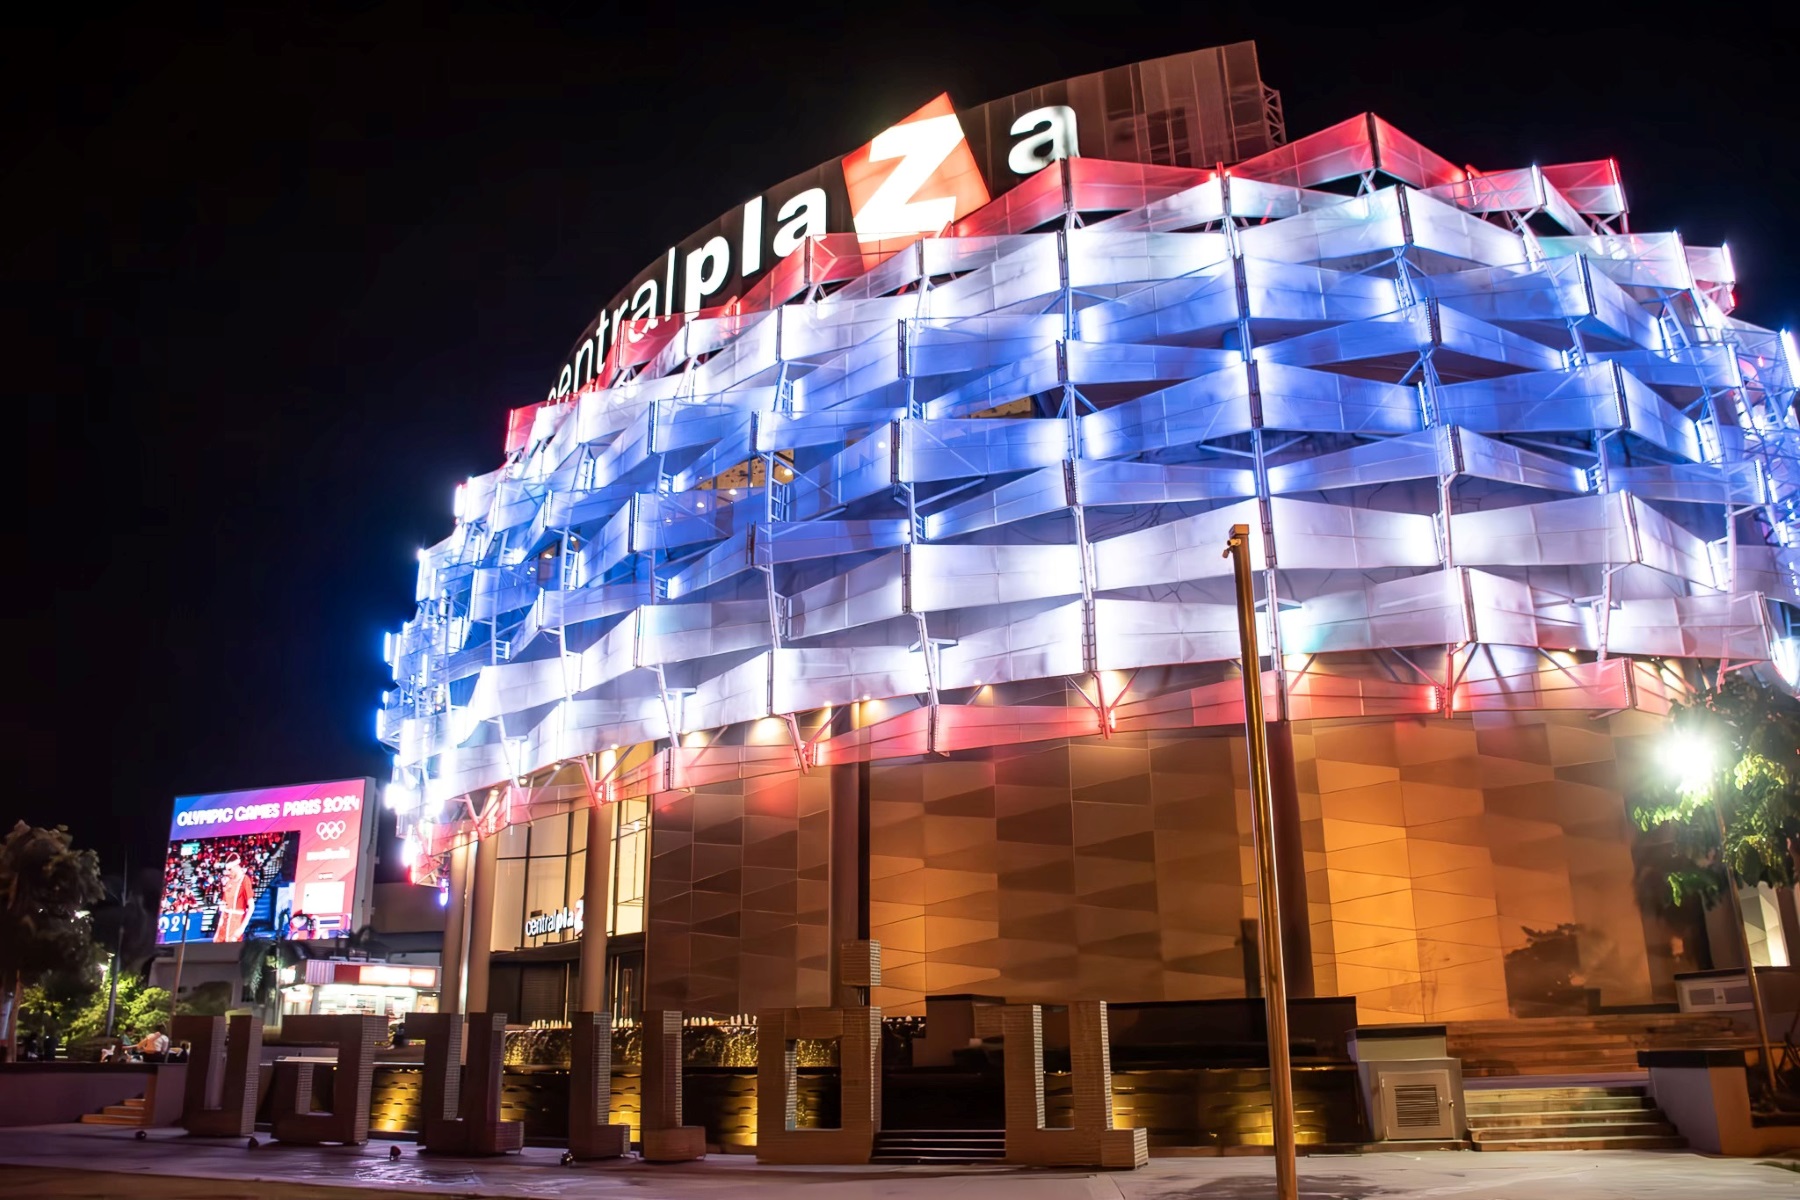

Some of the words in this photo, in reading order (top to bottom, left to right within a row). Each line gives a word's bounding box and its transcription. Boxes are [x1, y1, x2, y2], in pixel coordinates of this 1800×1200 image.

[177, 808, 233, 826] OLYMPIC
[235, 803, 280, 821] GAMES
[283, 799, 321, 817] PARIS
[323, 796, 360, 812] 2024
